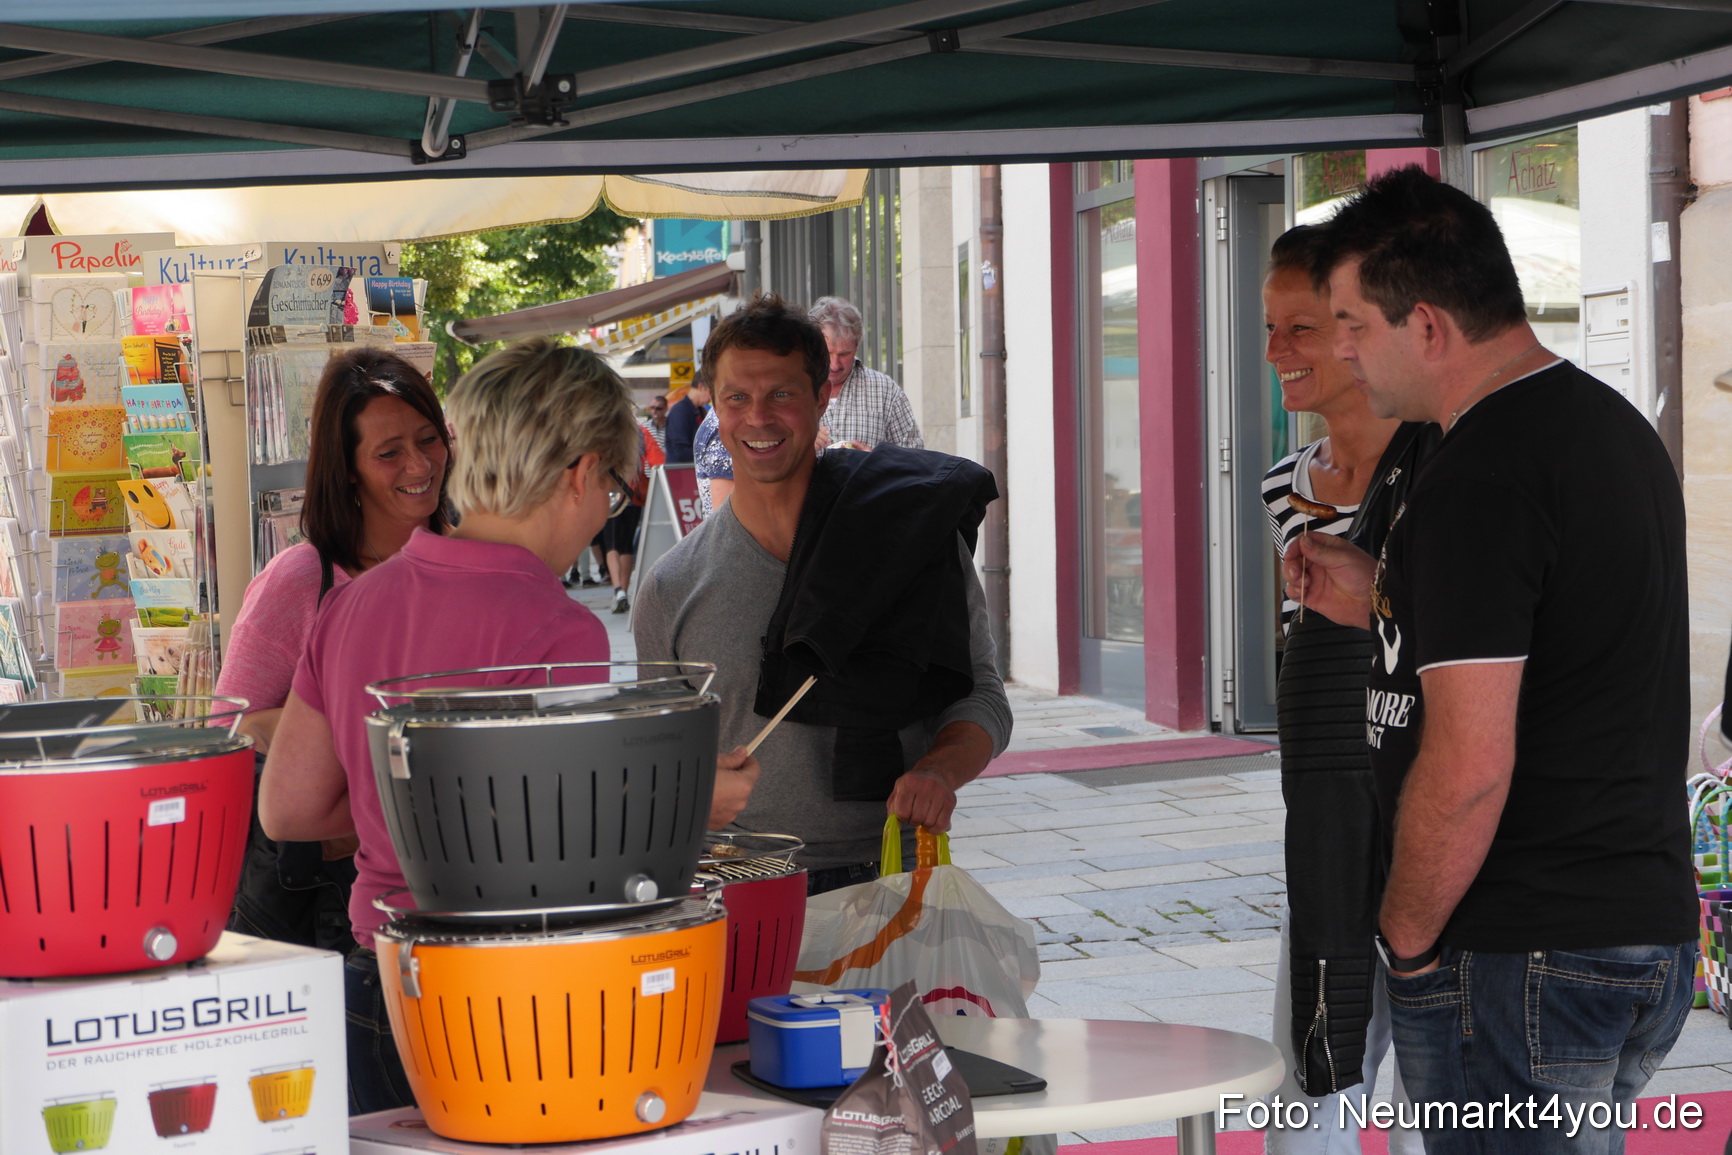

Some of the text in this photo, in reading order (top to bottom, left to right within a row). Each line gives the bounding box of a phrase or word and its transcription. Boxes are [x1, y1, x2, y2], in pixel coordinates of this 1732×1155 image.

[1508, 151, 1556, 195] Achatz
[316, 273, 332, 288] 6,99
[371, 279, 411, 289] Happy Birthday
[126, 398, 150, 408] HAPPY
[167, 536, 187, 556] Gute
[631, 947, 691, 964] LOTUSGRILL
[46, 990, 308, 1047] LOTUSGRILL
[47, 1025, 309, 1071] DER RAUCHFREIE HOLZKOHLEGRILL
